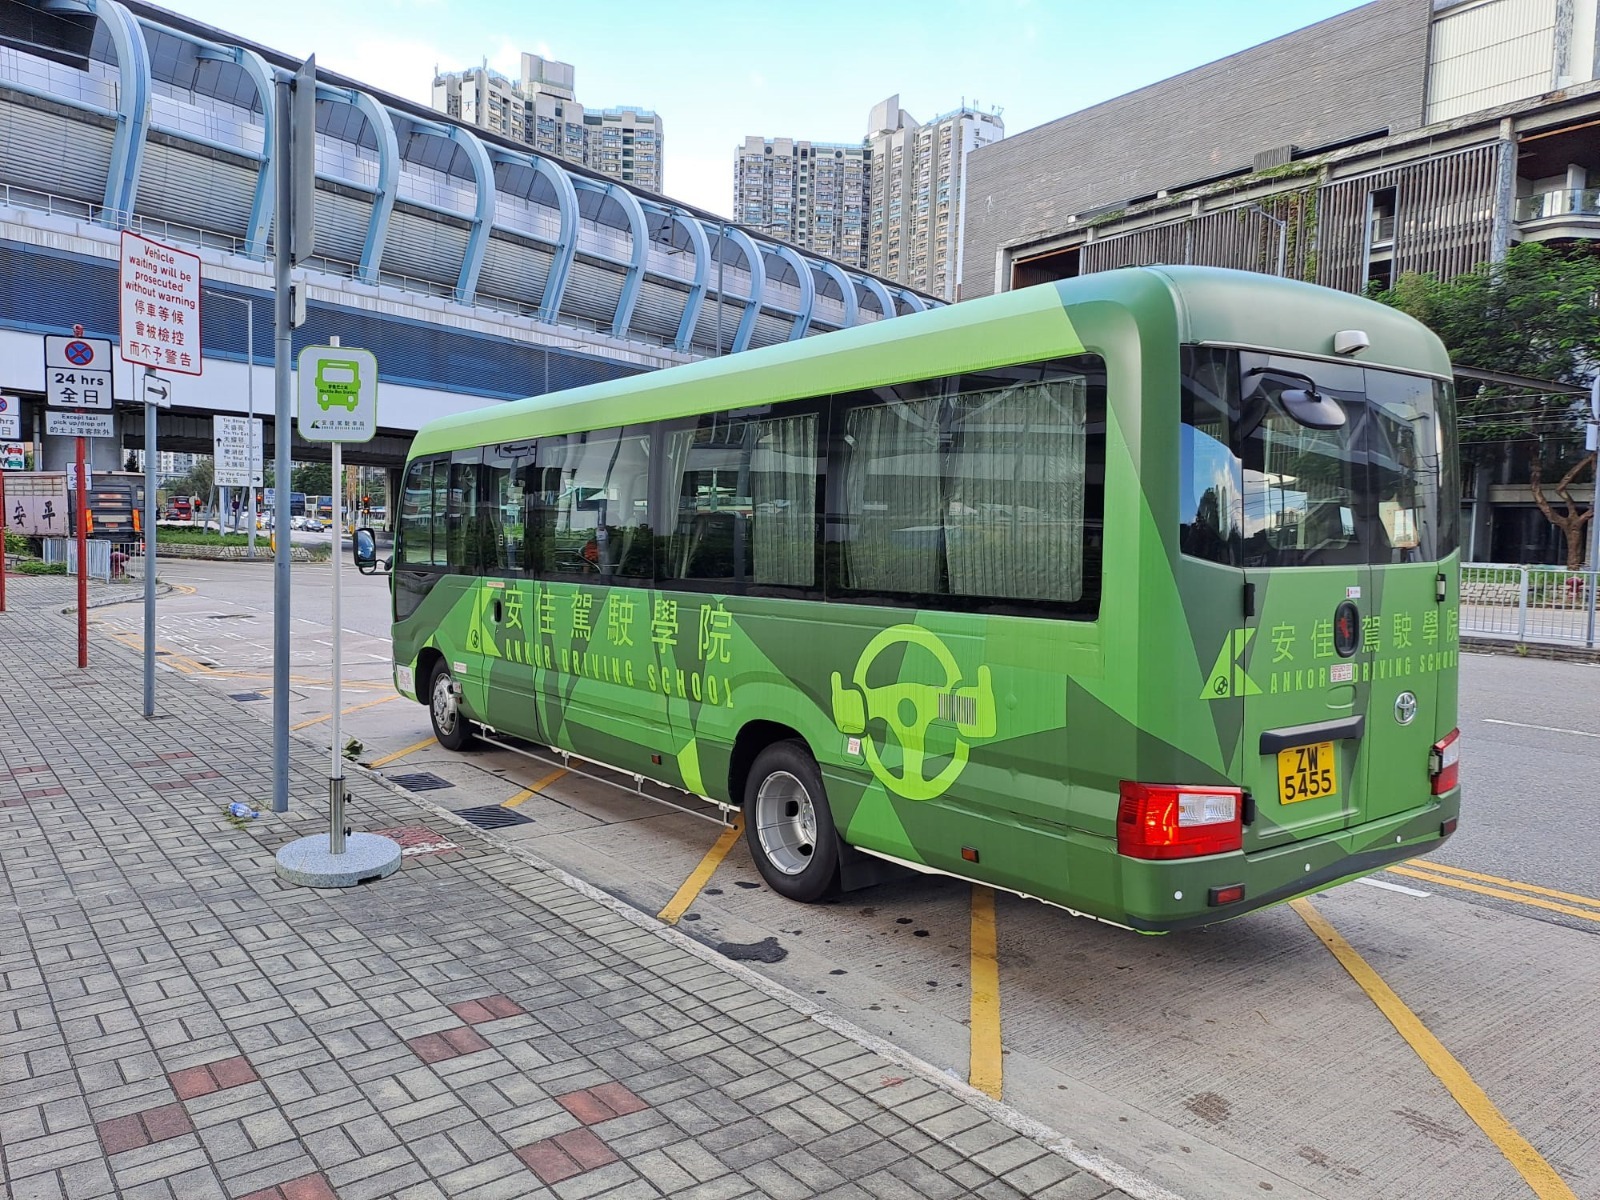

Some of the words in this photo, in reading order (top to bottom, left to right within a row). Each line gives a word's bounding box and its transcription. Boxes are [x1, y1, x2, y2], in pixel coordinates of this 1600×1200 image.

[129, 255, 158, 274] waiting
[160, 266, 177, 278] will
[180, 270, 192, 282] be
[144, 245, 175, 265] Vehicle
[125, 280, 156, 298] without
[158, 292, 196, 310] warning
[135, 271, 184, 293] prosecuted
[134, 298, 185, 326] 停車等候
[135, 320, 185, 346] 會被檢控
[129, 340, 192, 367] 而不予警告
[54, 372, 76, 384] 24
[81, 375, 104, 386] hrs
[60, 387, 99, 404] 全日
[504, 584, 733, 664] 安佳駕駛學院
[1270, 608, 1458, 664] 安佳駕駛學院
[505, 638, 552, 670] ANKOR
[561, 648, 635, 686] DRIVING
[648, 664, 734, 708] SCHOOL
[1270, 668, 1326, 694] ANKOR
[1352, 656, 1411, 684] DRIVING
[1420, 650, 1458, 673] SCHOOL
[1296, 746, 1318, 774] ZW
[1284, 769, 1332, 800] 5455
